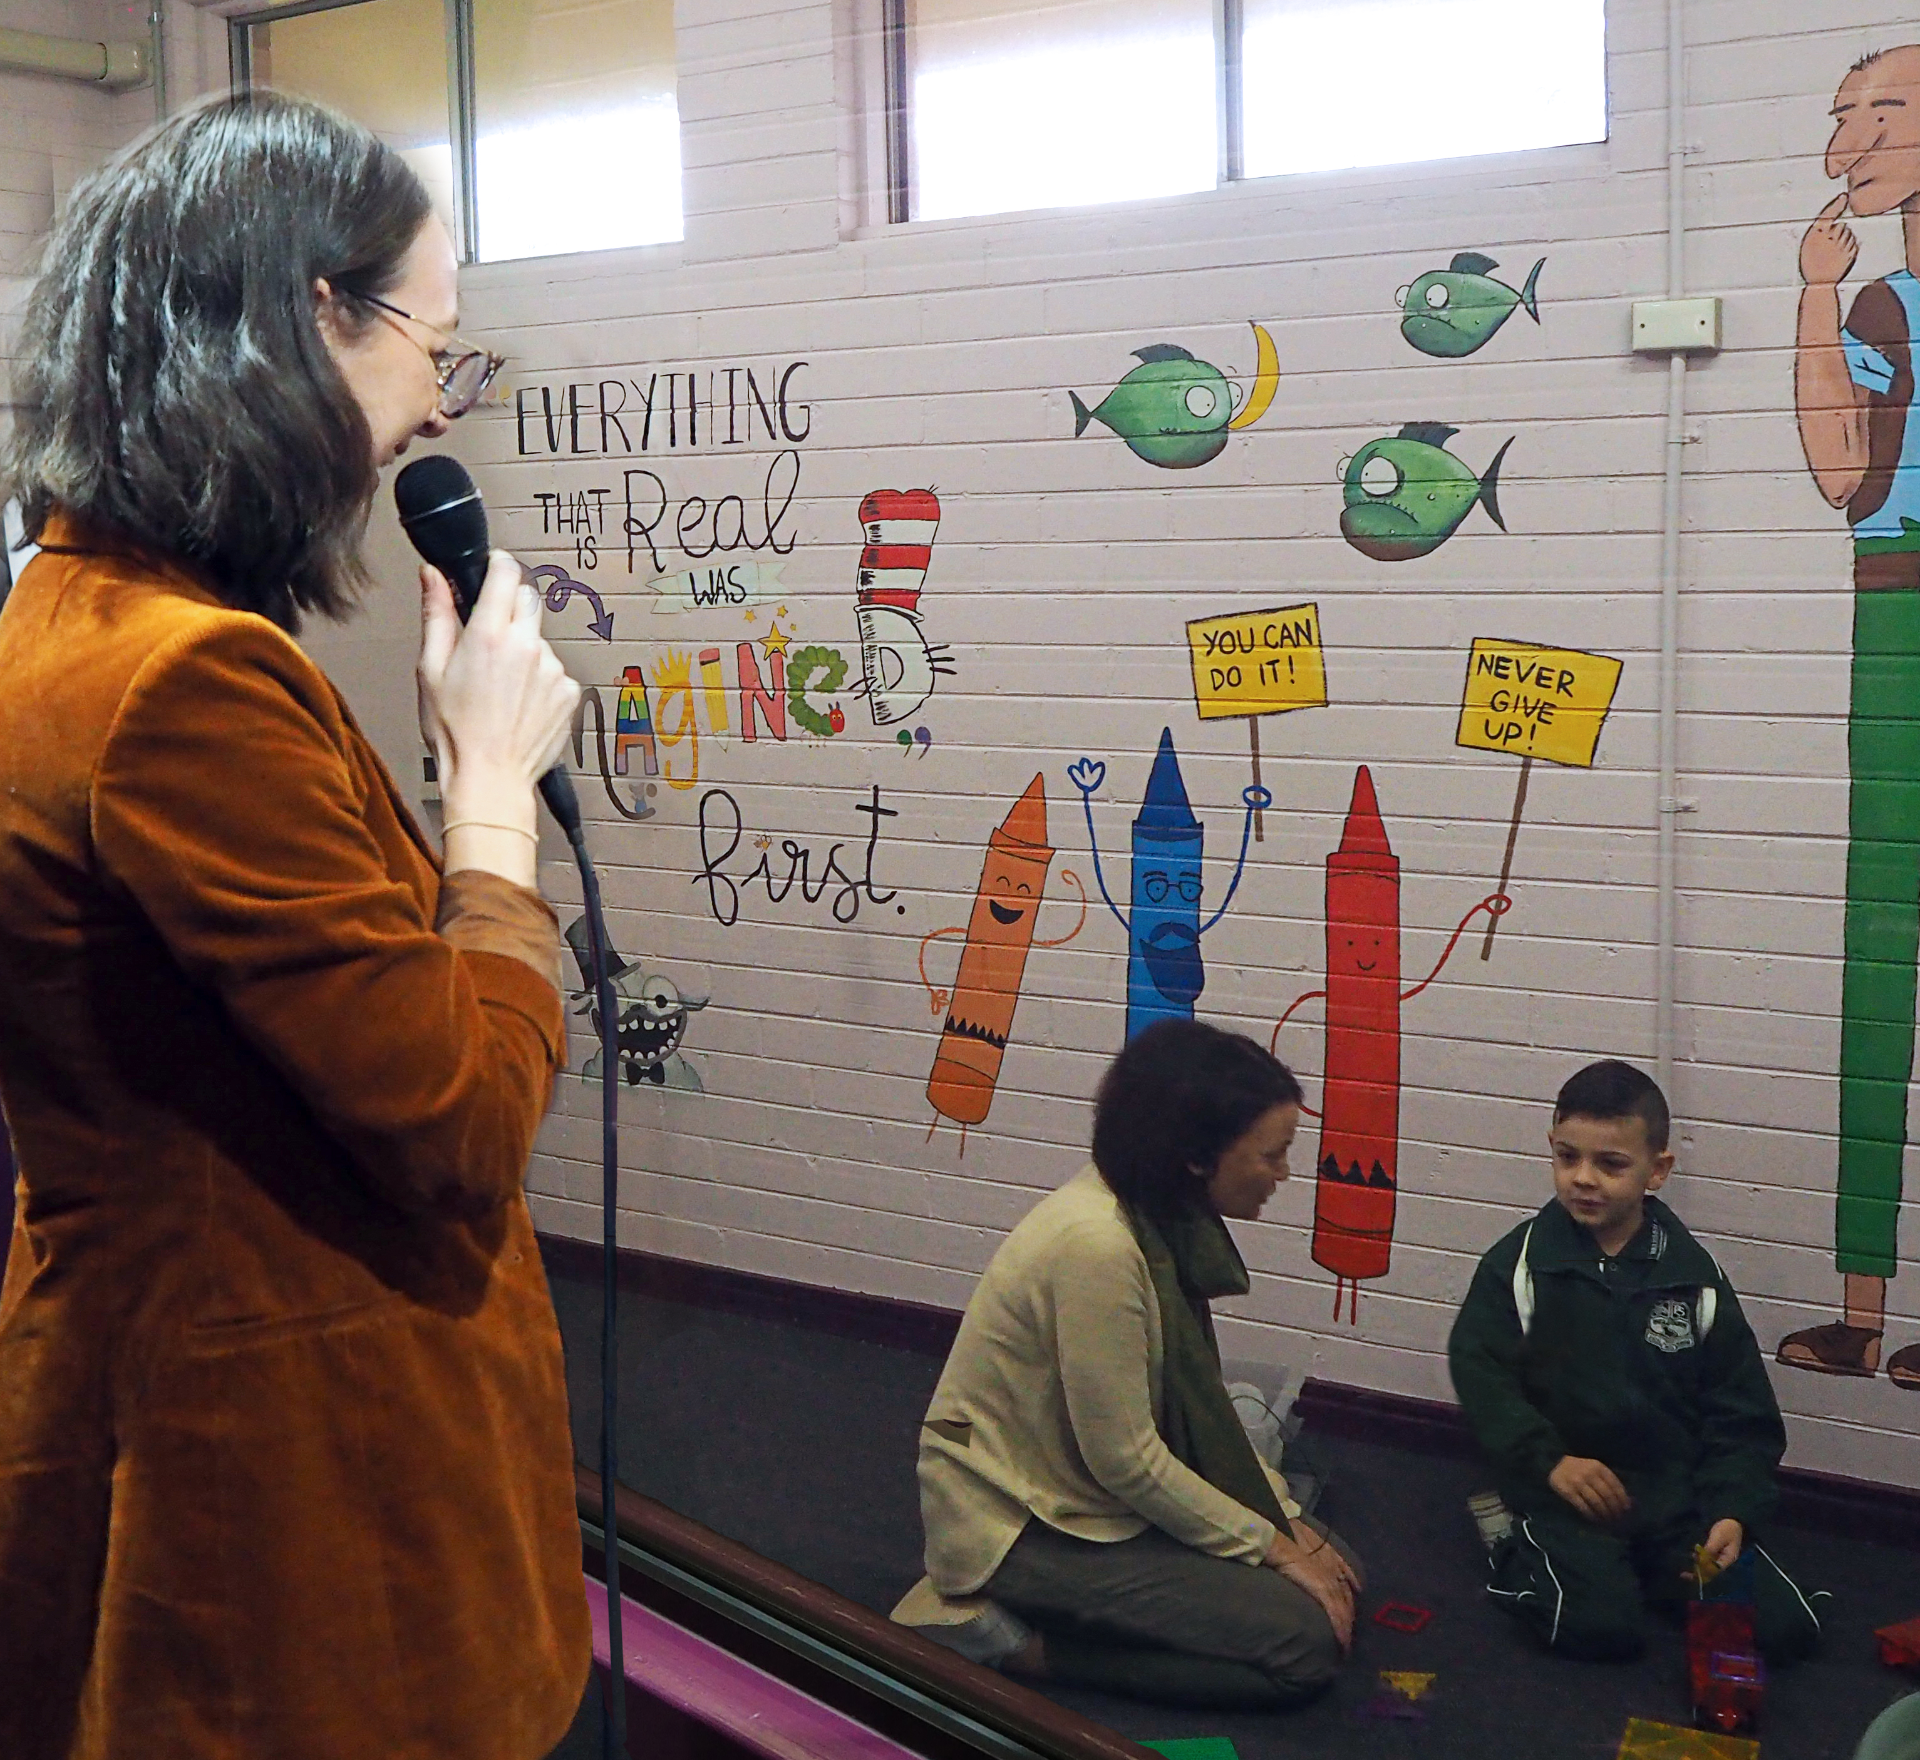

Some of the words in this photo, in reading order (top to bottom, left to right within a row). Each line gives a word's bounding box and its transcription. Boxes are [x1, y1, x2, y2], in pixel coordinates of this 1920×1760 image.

[533, 489, 611, 534] THAT
[576, 536, 599, 571] IS
[622, 450, 800, 574] Real
[689, 568, 747, 604] WAS
[1203, 629, 1255, 656] YOU
[1263, 618, 1313, 648] CAN
[1211, 666, 1242, 691] DO
[1259, 654, 1296, 685] IT!
[1476, 653, 1575, 698] NEVER
[1489, 689, 1558, 726] GIVE
[1484, 721, 1537, 751] UP!
[692, 785, 906, 926] first.
